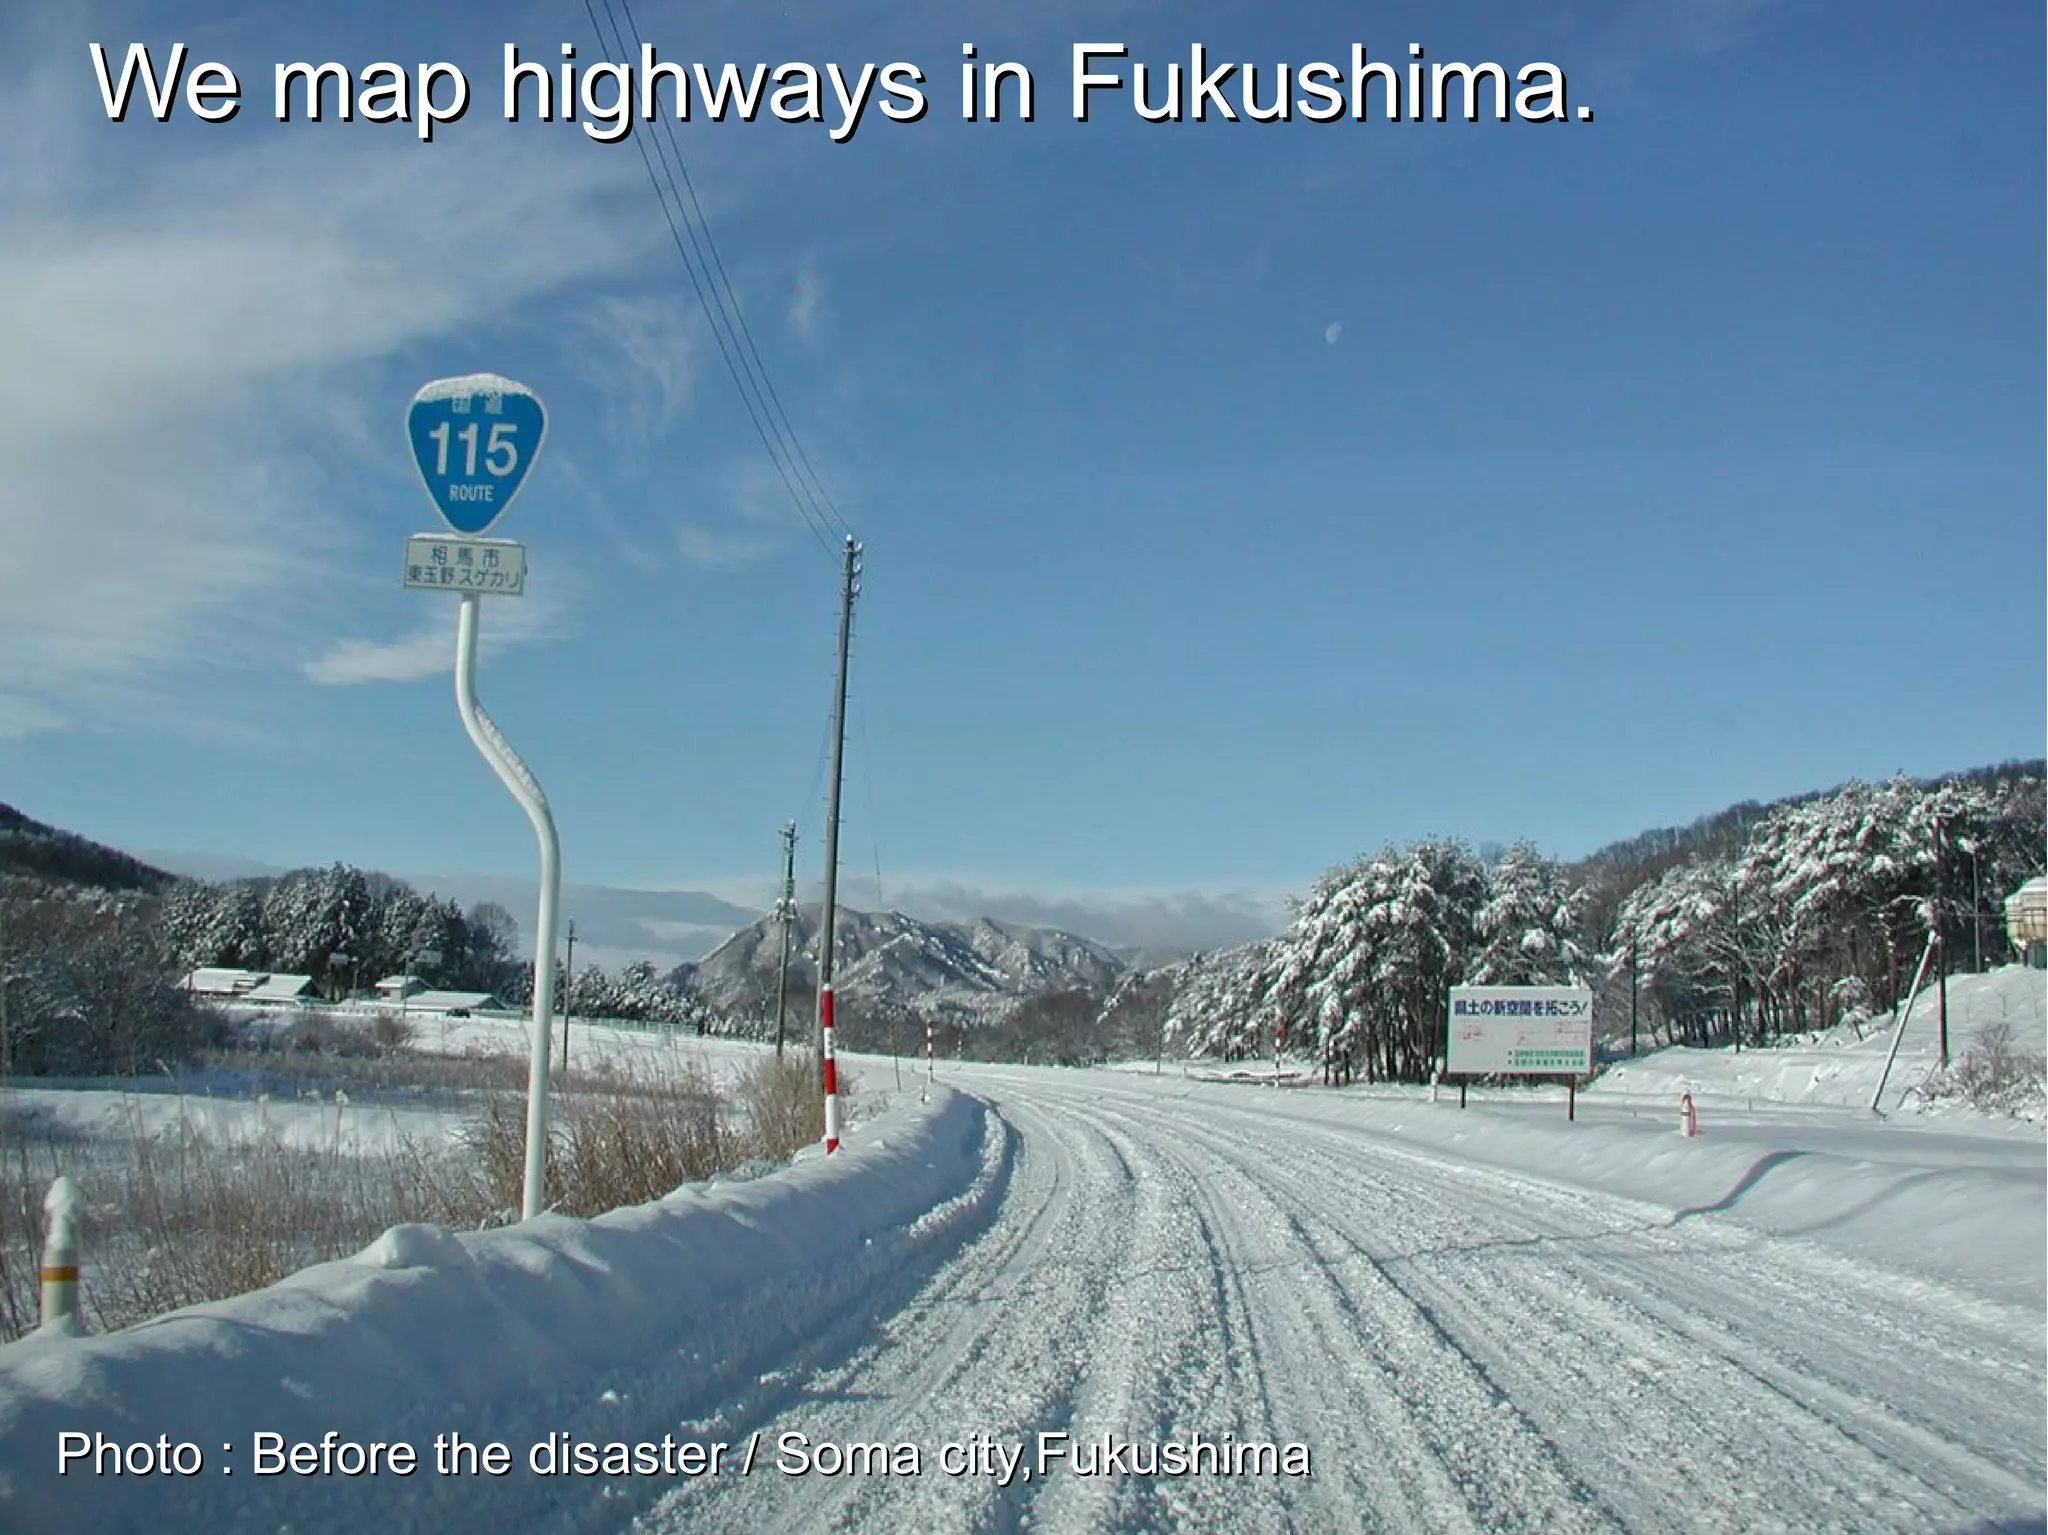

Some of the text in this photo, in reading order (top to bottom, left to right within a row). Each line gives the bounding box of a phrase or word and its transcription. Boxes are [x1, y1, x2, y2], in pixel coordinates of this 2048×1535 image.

[429, 420, 518, 477] 115
[449, 484, 494, 502] ROUTE
[431, 545, 500, 568] 相馬市
